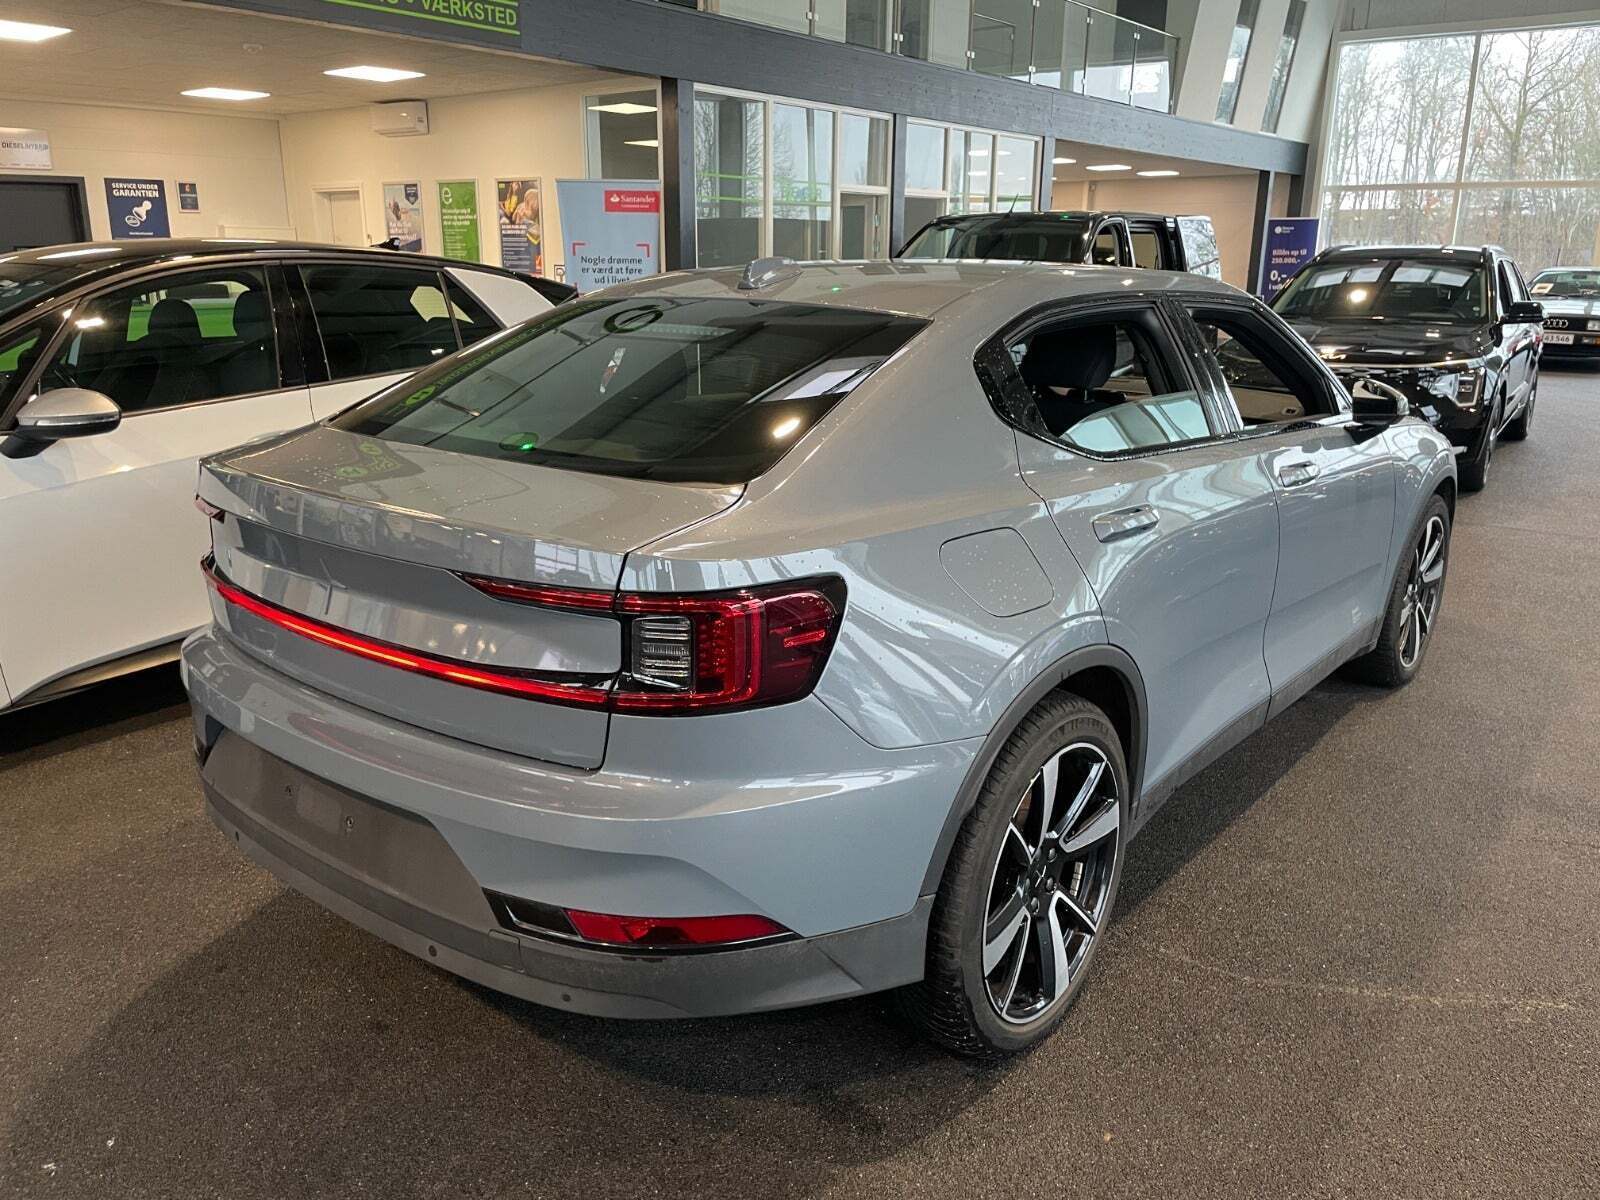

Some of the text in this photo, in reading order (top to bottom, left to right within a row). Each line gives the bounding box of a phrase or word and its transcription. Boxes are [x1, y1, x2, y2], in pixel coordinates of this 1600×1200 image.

[421, 0, 517, 26] VÆRKSTED
[113, 189, 159, 198] GARANTIEN
[620, 195, 656, 204] Santander
[581, 256, 643, 266] Nogle drømme
[592, 266, 613, 274] værd
[625, 266, 643, 274] føre
[595, 276, 605, 284] ud
[1270, 270, 1287, 282] 0,-
